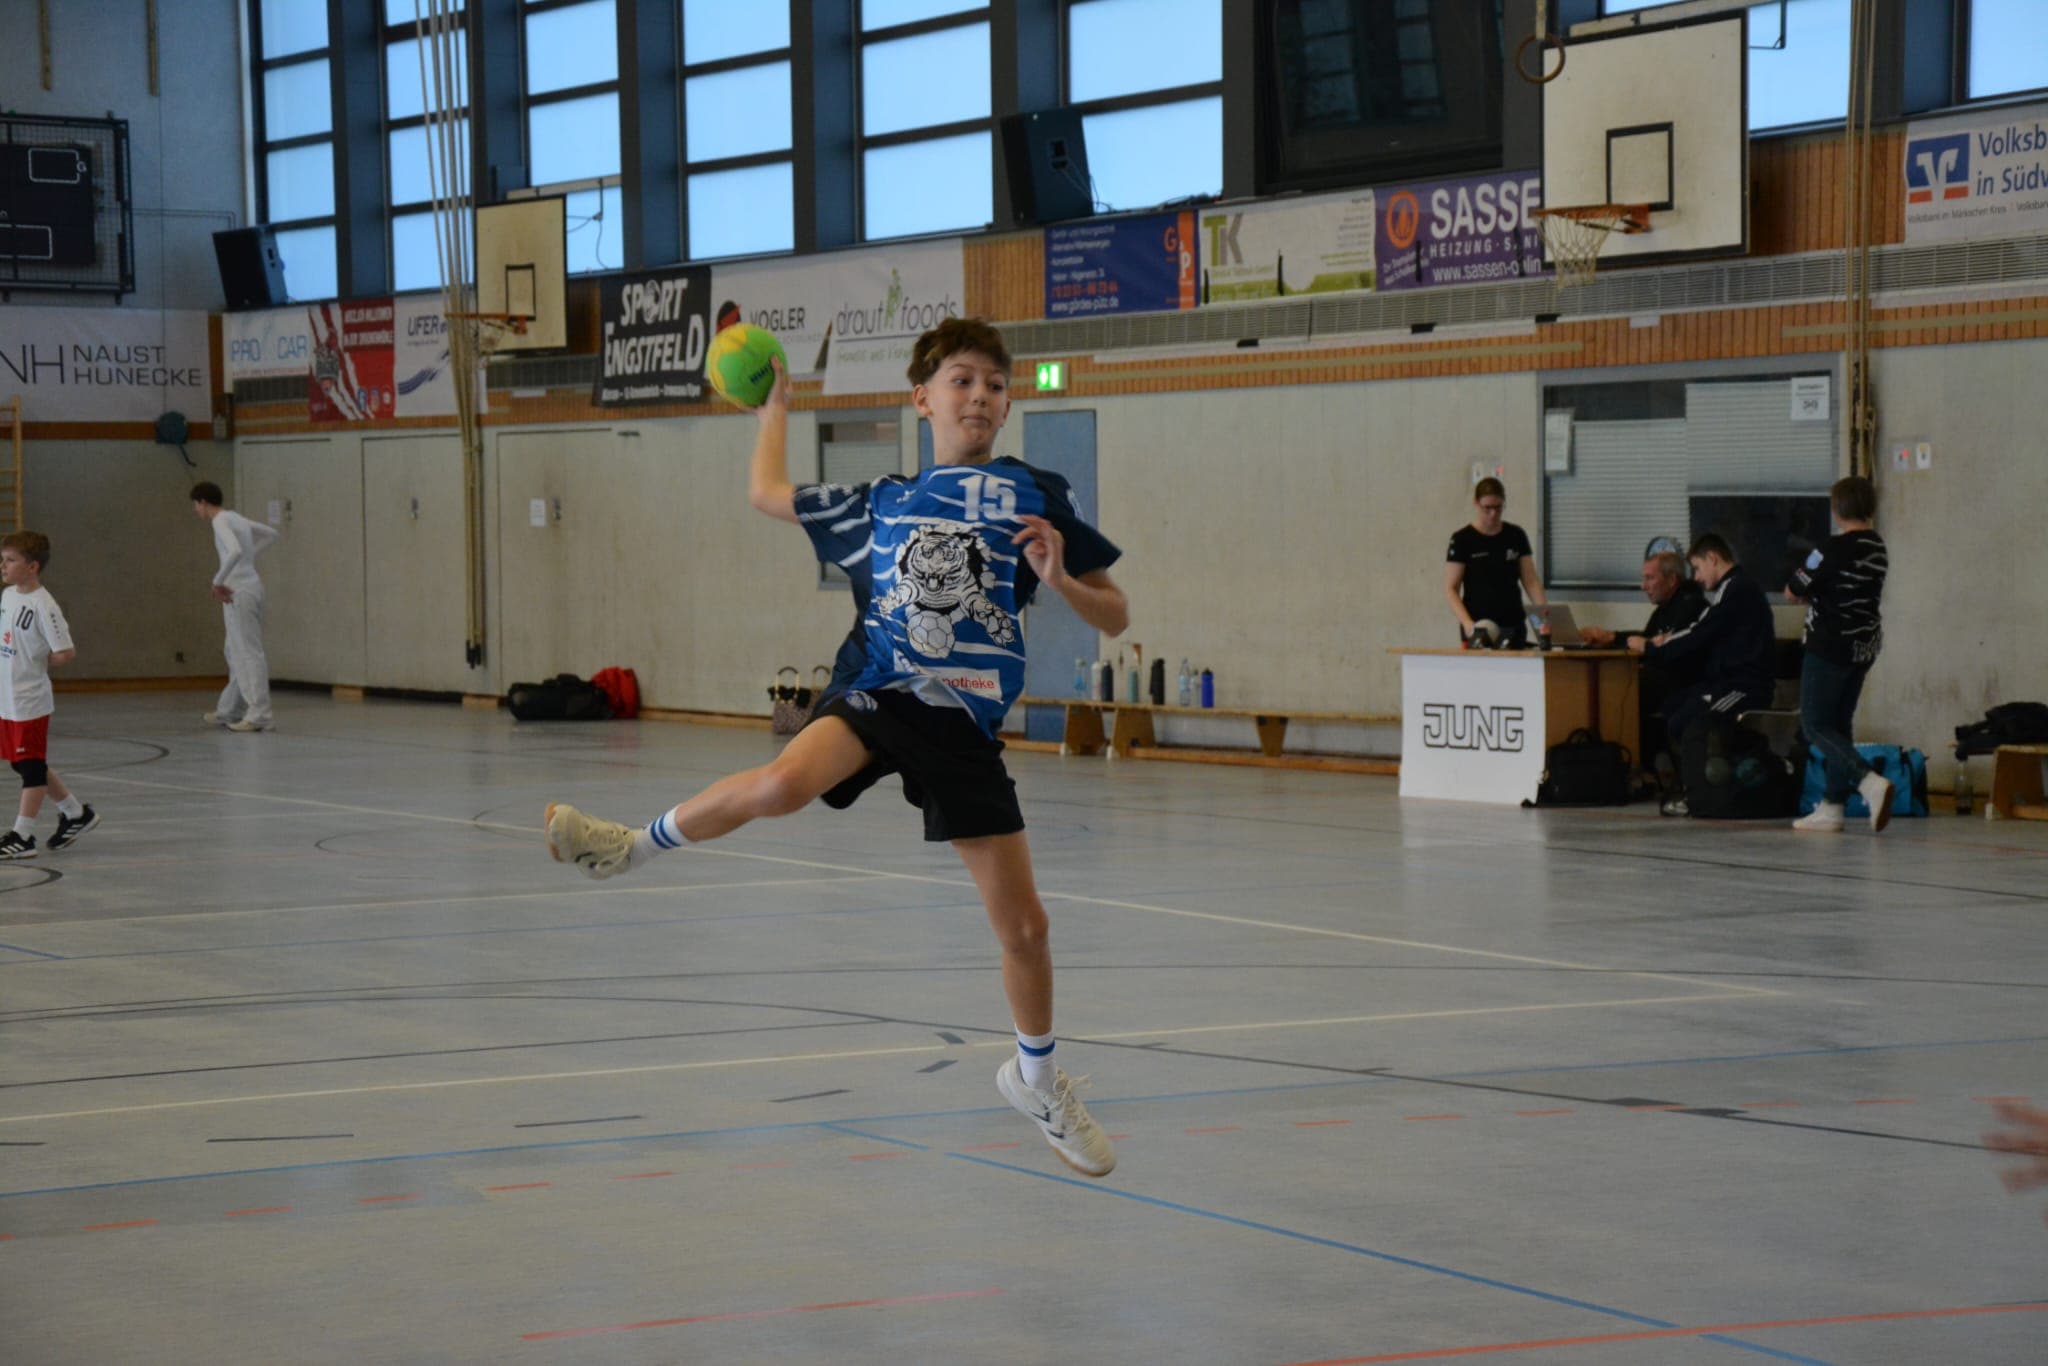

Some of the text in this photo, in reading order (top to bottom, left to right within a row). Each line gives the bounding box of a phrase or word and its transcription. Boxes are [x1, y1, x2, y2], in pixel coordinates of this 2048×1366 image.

[1976, 171, 1994, 196] in
[1431, 178, 1540, 239] SASSE
[1202, 213, 1243, 266] TK
[1430, 242, 1493, 258] HEIZUNG
[621, 278, 688, 327] SPORT
[750, 306, 807, 333] VOGLER
[73, 345, 165, 366] NAUST
[276, 334, 309, 360] CAR
[604, 315, 703, 378] ENGSTFELD
[73, 367, 201, 388] HUNECKE
[958, 474, 1017, 521] 15
[15, 605, 34, 631] 10
[1423, 703, 1524, 753] JUNG
